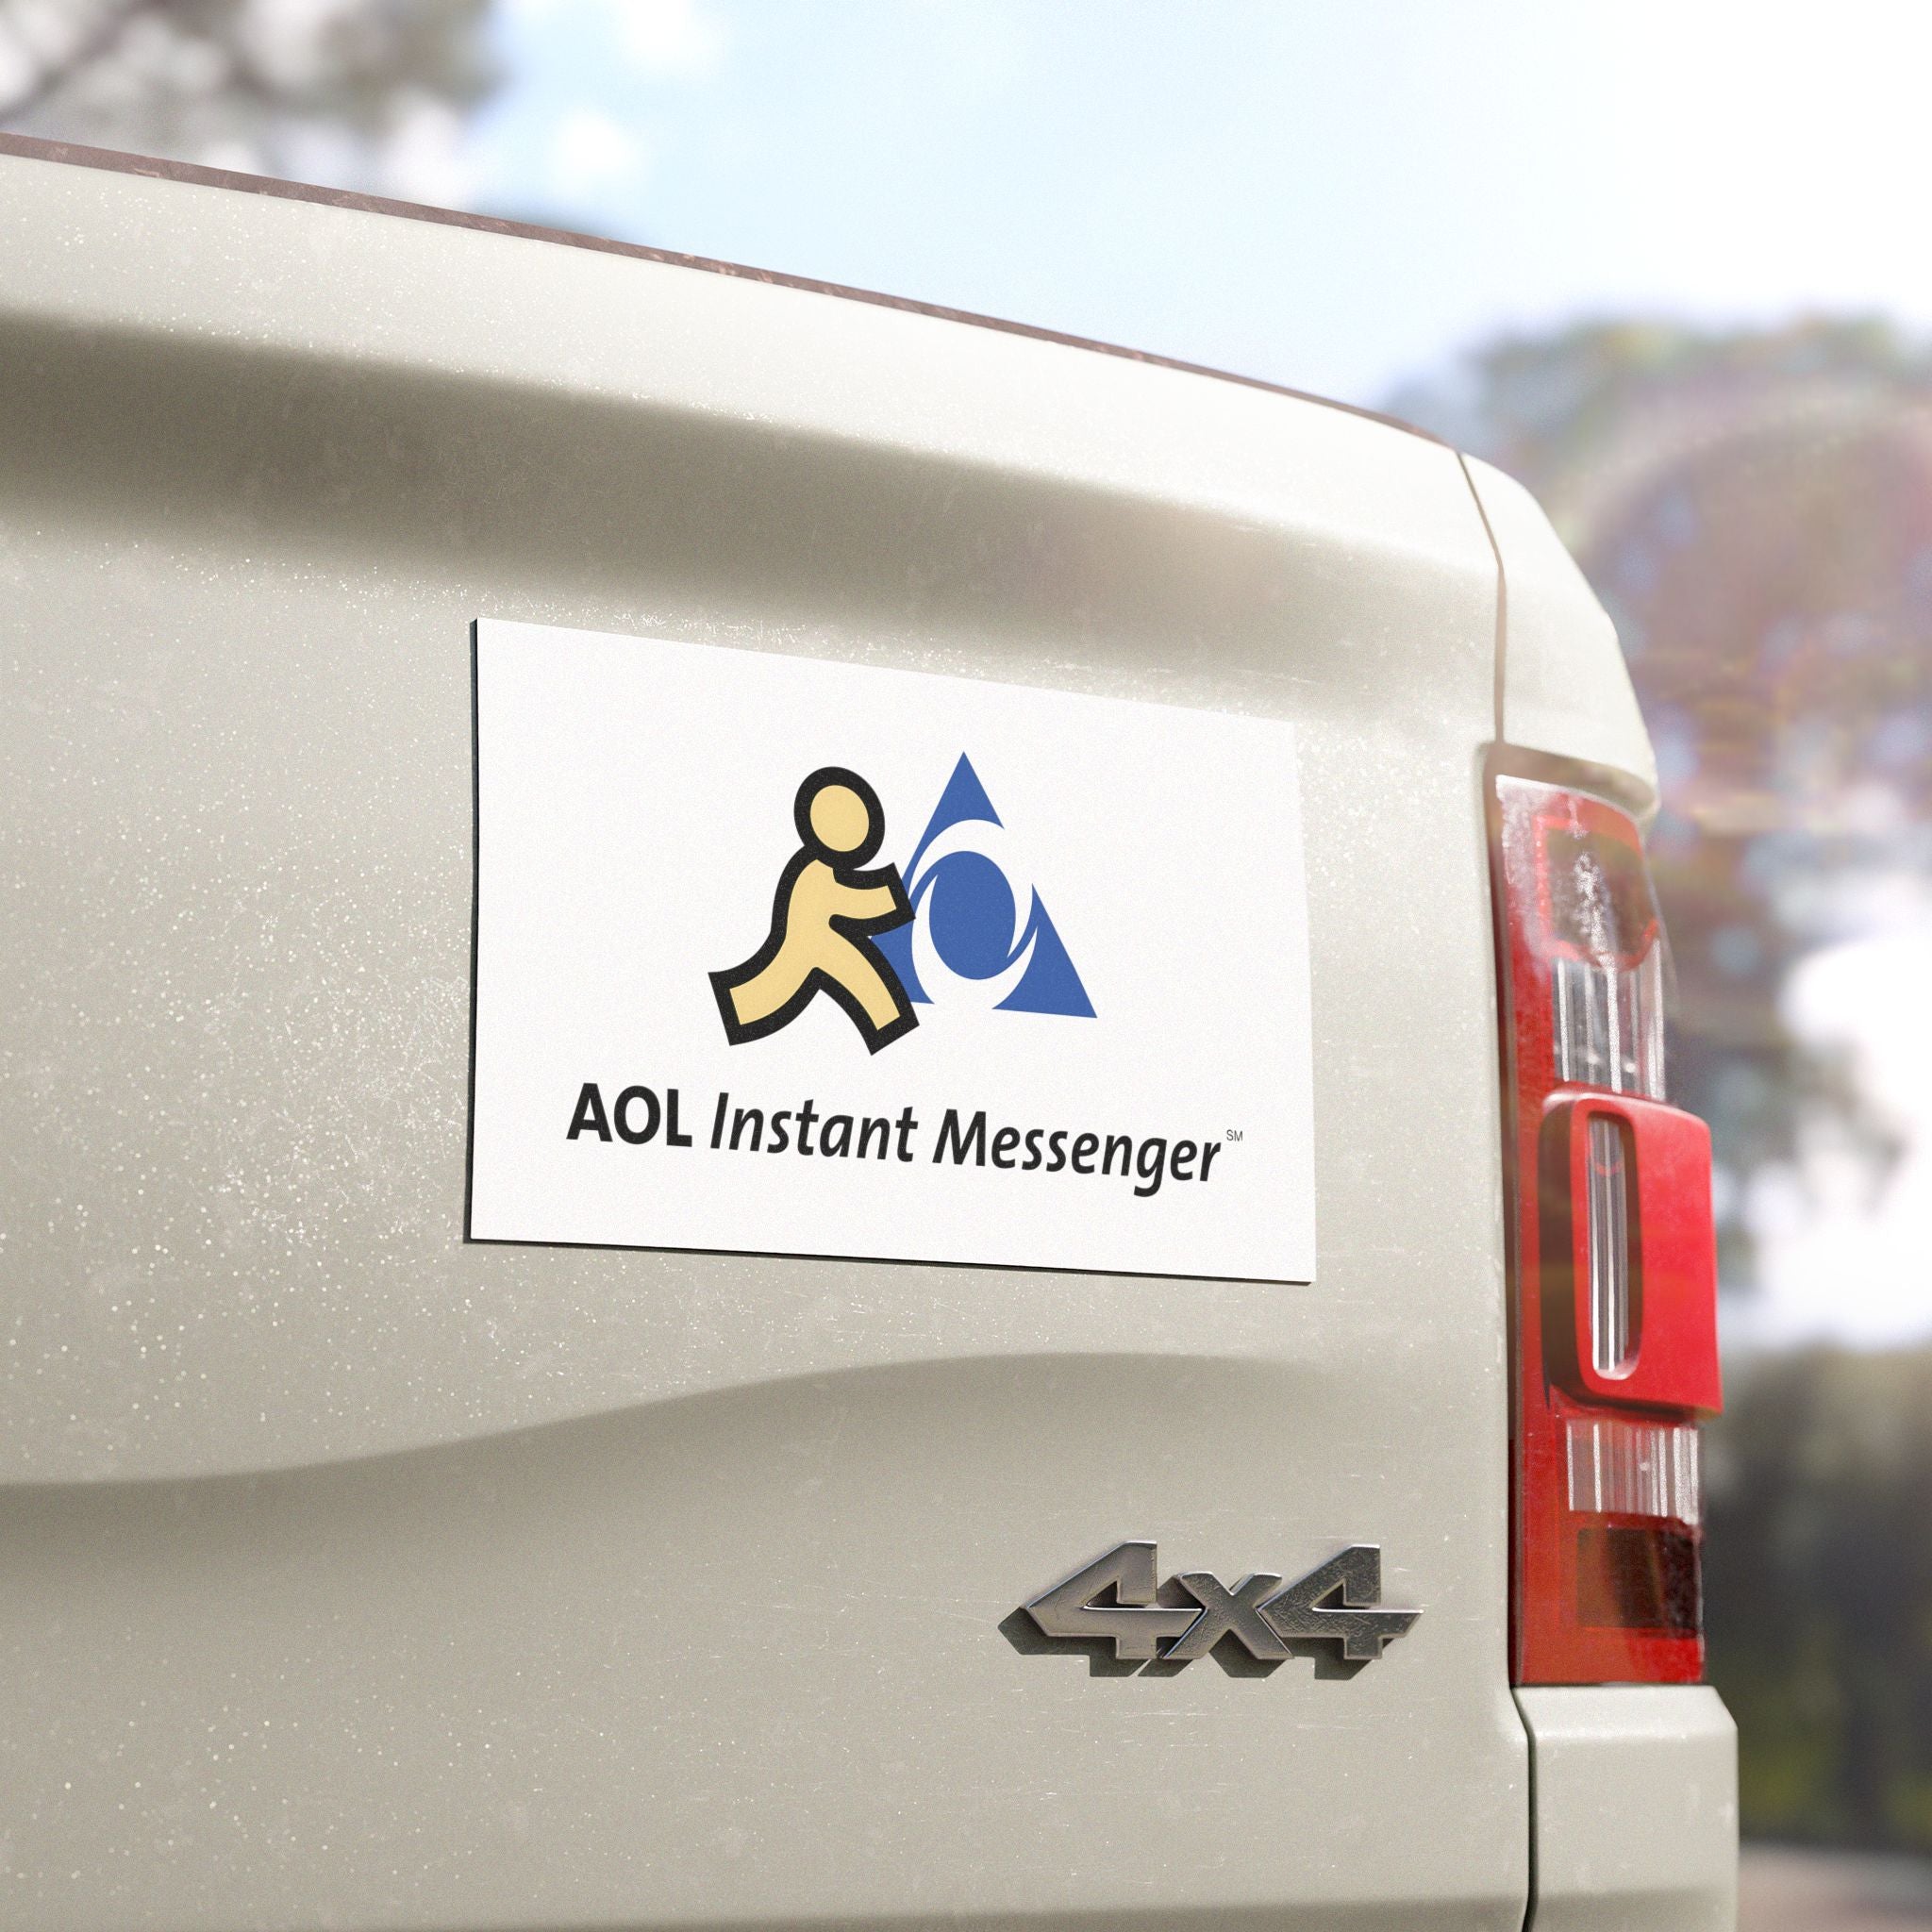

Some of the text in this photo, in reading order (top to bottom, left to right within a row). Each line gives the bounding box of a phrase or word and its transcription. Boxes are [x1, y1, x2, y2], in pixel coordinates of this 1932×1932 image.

[566, 1082, 692, 1148] AOL
[709, 1091, 919, 1163] Instant
[932, 1108, 1222, 1198] Messenger
[1024, 1540, 1424, 1659] 4x4
